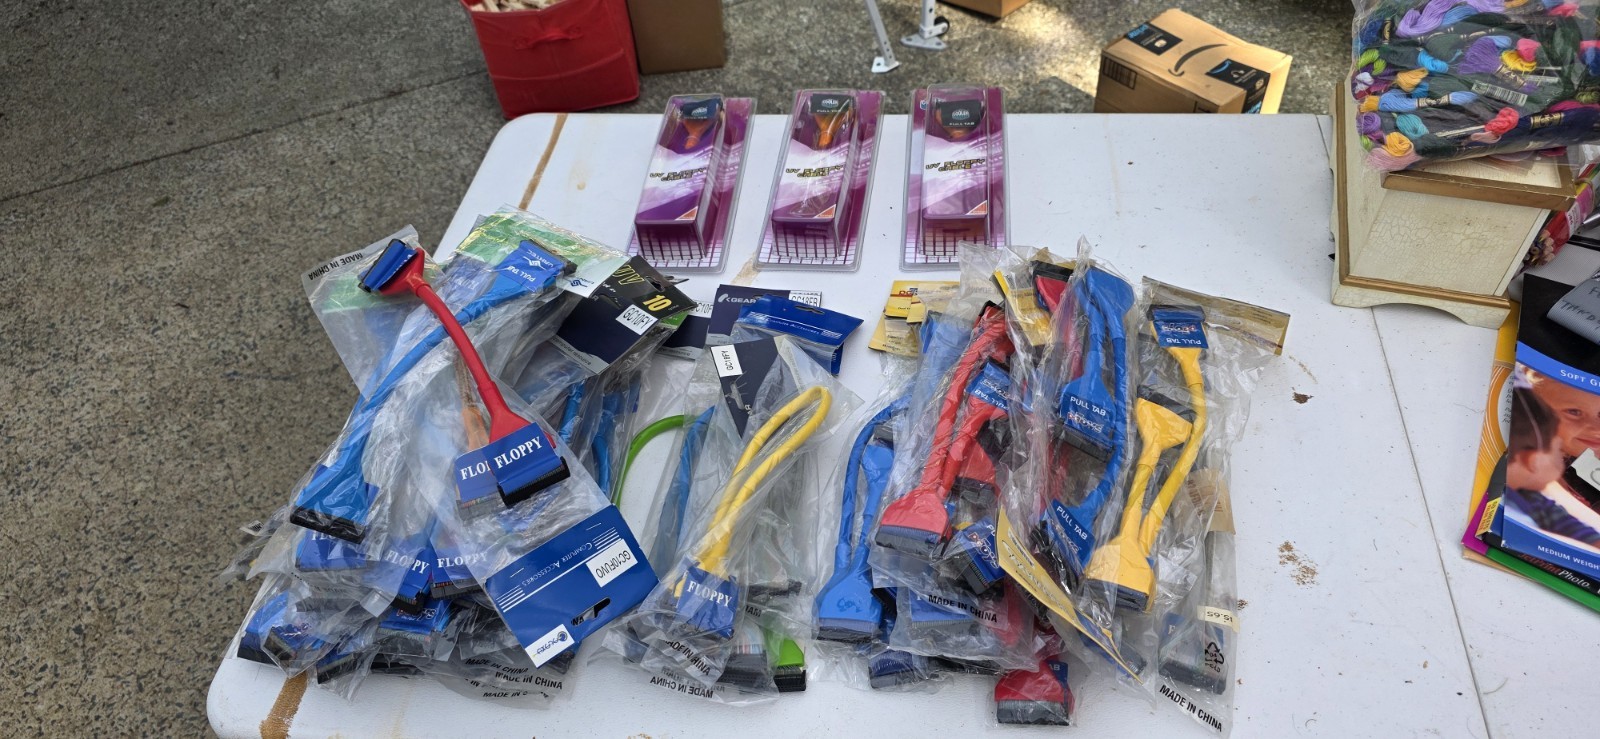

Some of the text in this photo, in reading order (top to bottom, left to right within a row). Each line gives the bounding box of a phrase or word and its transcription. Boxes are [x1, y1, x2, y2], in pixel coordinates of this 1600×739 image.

[308, 252, 364, 281] MADE IN CHINA
[519, 270, 536, 282] PULL
[642, 294, 672, 312] 10
[1560, 369, 1586, 383] SOFT
[974, 388, 989, 401] TAB
[1070, 396, 1107, 416] PULL TAB
[493, 436, 543, 469] FLOPPY
[1056, 505, 1073, 526] PULL
[1073, 524, 1088, 540] TAB
[385, 550, 430, 575] FLOPPY
[436, 551, 487, 569] FLOPPY
[1537, 545, 1571, 561] MEDIUM
[522, 542, 593, 586] COMPUTER ACCESSORIES
[595, 550, 631, 578] GC10FUVO
[1558, 569, 1590, 588] Photo
[687, 581, 733, 608] FLOPPY
[928, 594, 998, 623] MADE IN CHINA
[465, 658, 490, 666] MADE
[501, 666, 528, 674] CHINA
[534, 676, 563, 690] CHINA
[1160, 684, 1223, 733] MADE IN CHINA
